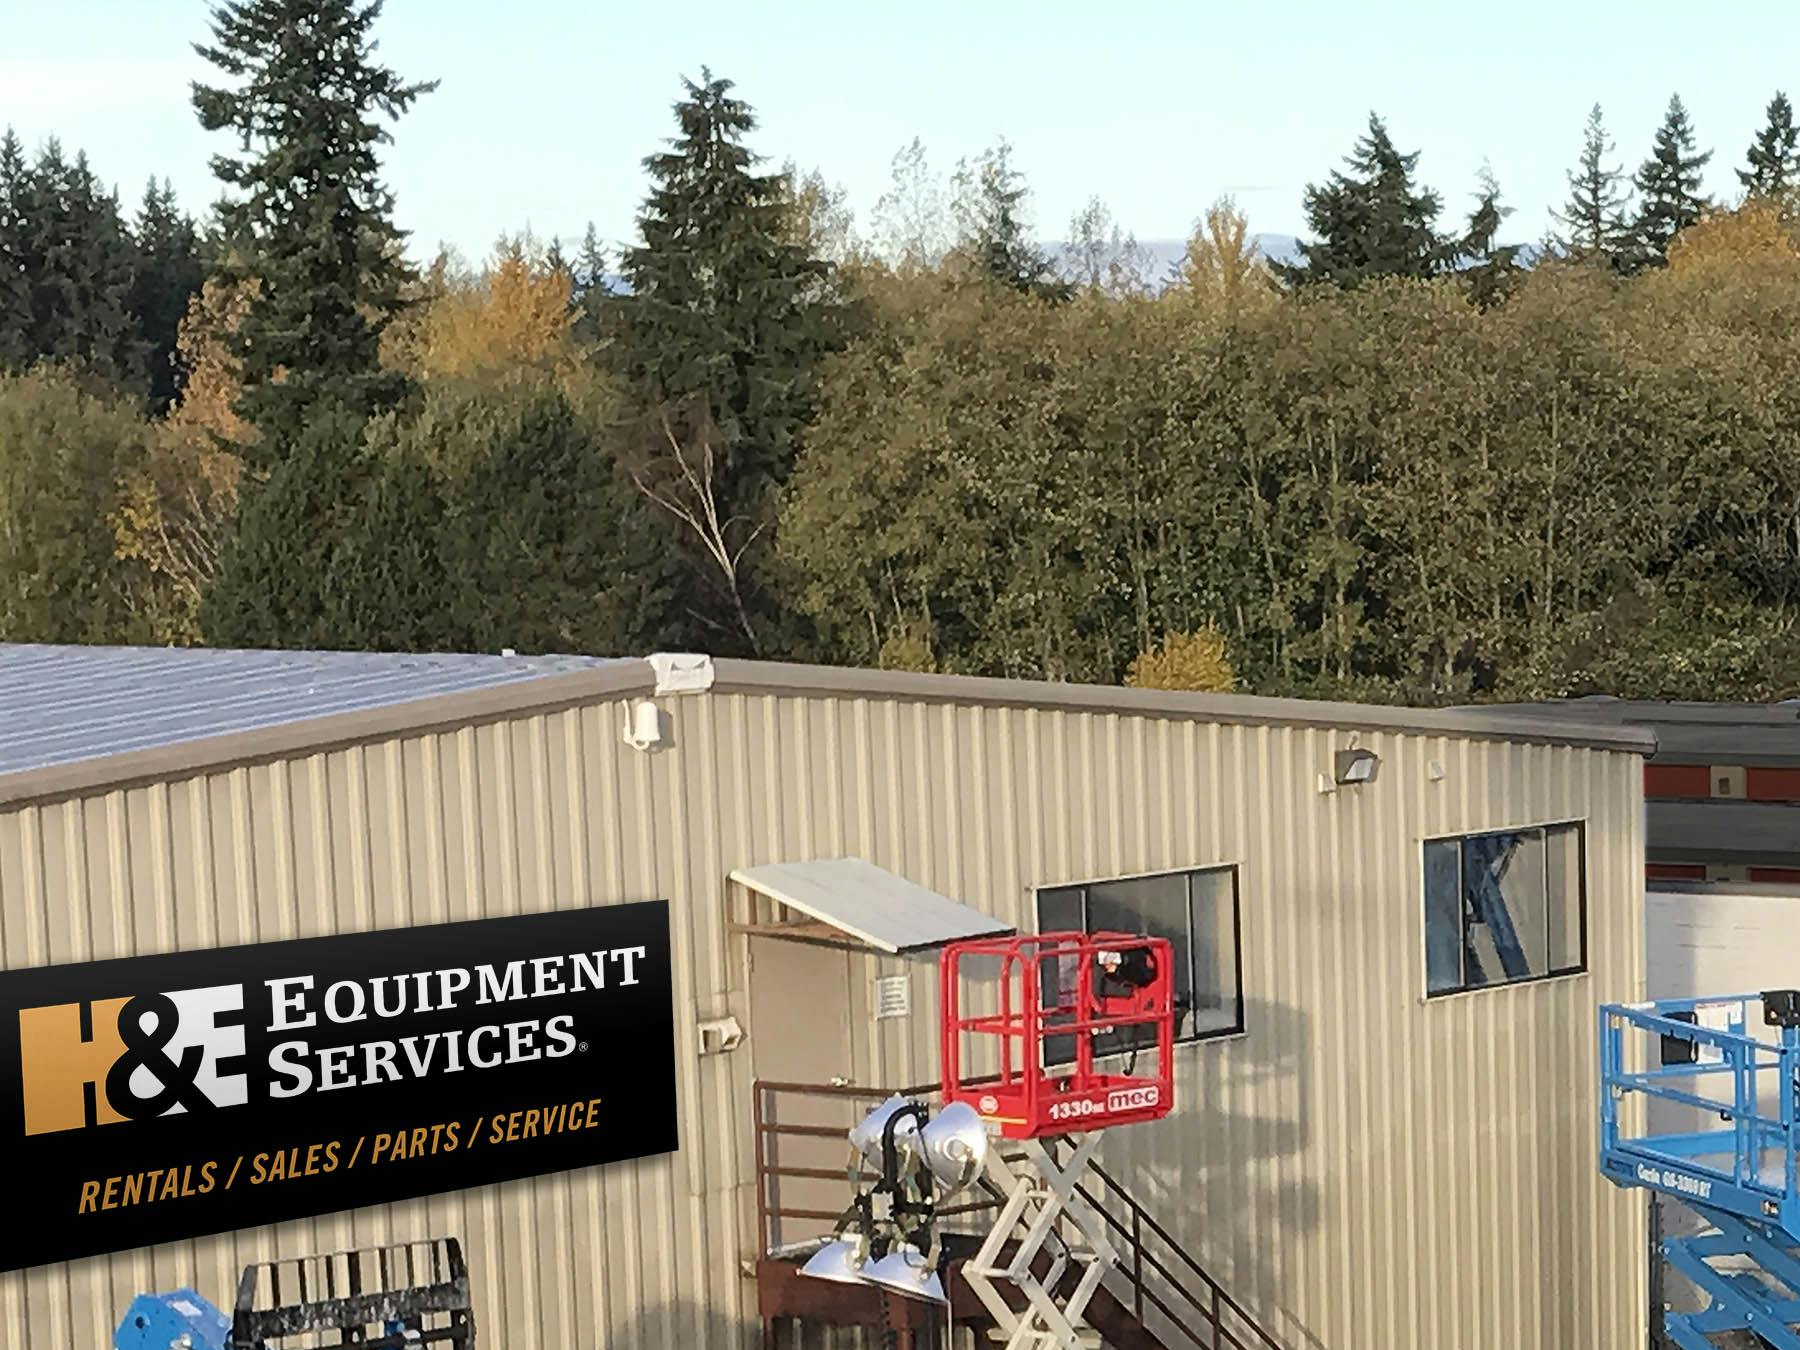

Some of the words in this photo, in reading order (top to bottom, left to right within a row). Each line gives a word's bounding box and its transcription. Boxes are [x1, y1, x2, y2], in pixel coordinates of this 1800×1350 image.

[18, 983, 249, 1137] H&E
[263, 945, 646, 1033] EQUIPMENT
[268, 1015, 578, 1098] SERVICES
[1110, 1090, 1157, 1110] mec
[78, 1161, 218, 1214] RENTALS
[250, 1141, 341, 1185] SALES
[371, 1121, 461, 1164] PARTS
[489, 1098, 602, 1144] SERVICE
